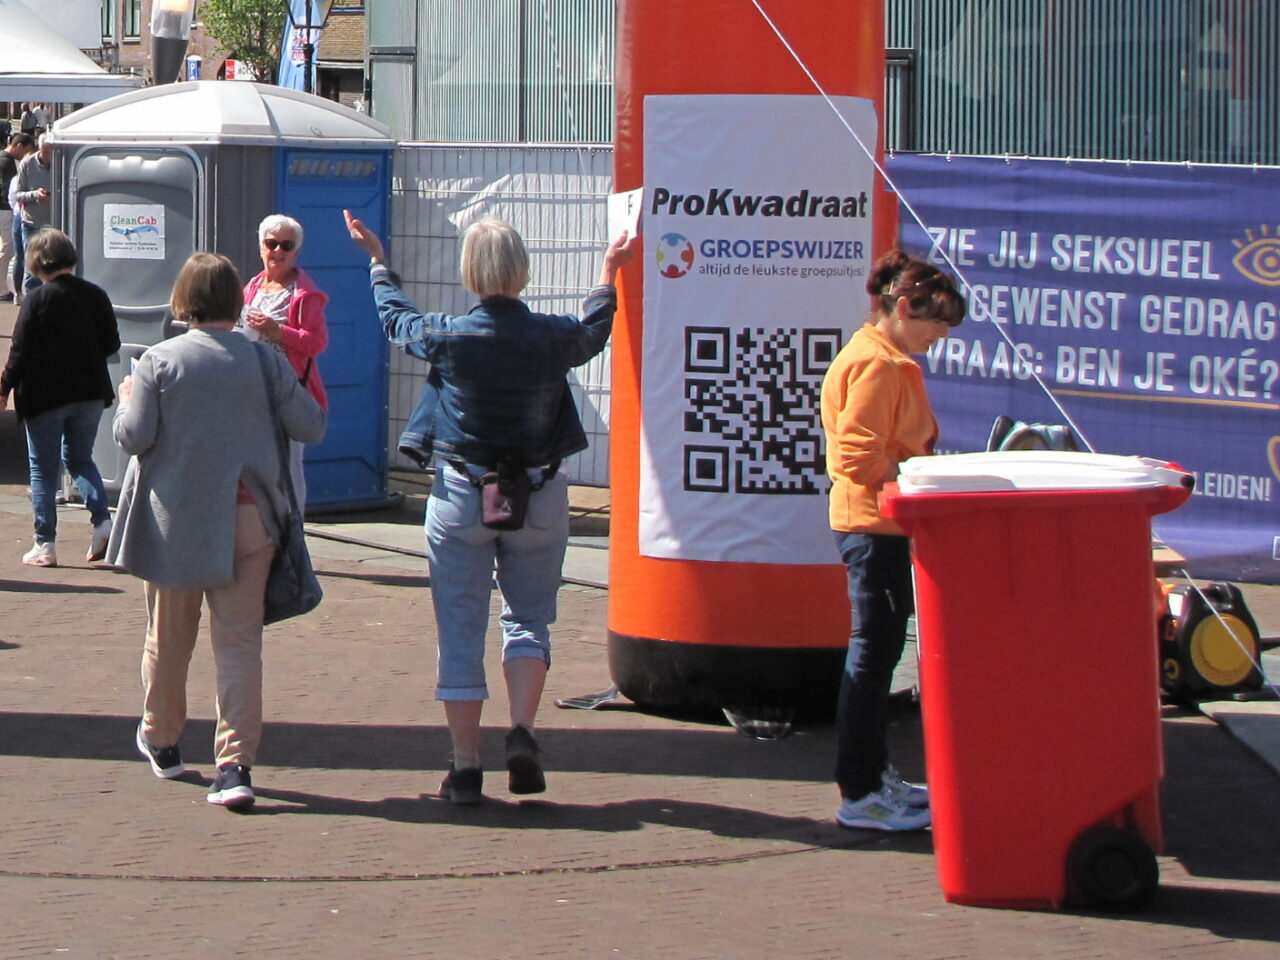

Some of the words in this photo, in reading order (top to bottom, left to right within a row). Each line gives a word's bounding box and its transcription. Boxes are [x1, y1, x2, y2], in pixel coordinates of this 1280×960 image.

[652, 188, 868, 218] ProKwadraat
[700, 239, 864, 260] GROEPSWIJZER
[927, 226, 977, 267] ZIE
[988, 230, 1038, 270] JIJ
[1050, 233, 1220, 281] SEKSUEEL
[698, 263, 730, 276] altijd
[733, 264, 750, 275] de
[800, 265, 864, 279] groepsuitjes!
[960, 284, 1126, 331] GEWENST
[1140, 295, 1280, 341] GEDRAG
[927, 338, 1044, 380] VRAAG:
[1056, 345, 1120, 388] BEN
[1133, 351, 1175, 392] JE
[1189, 347, 1280, 400] OKÉ?
[1191, 471, 1271, 502] LEIDEN!
